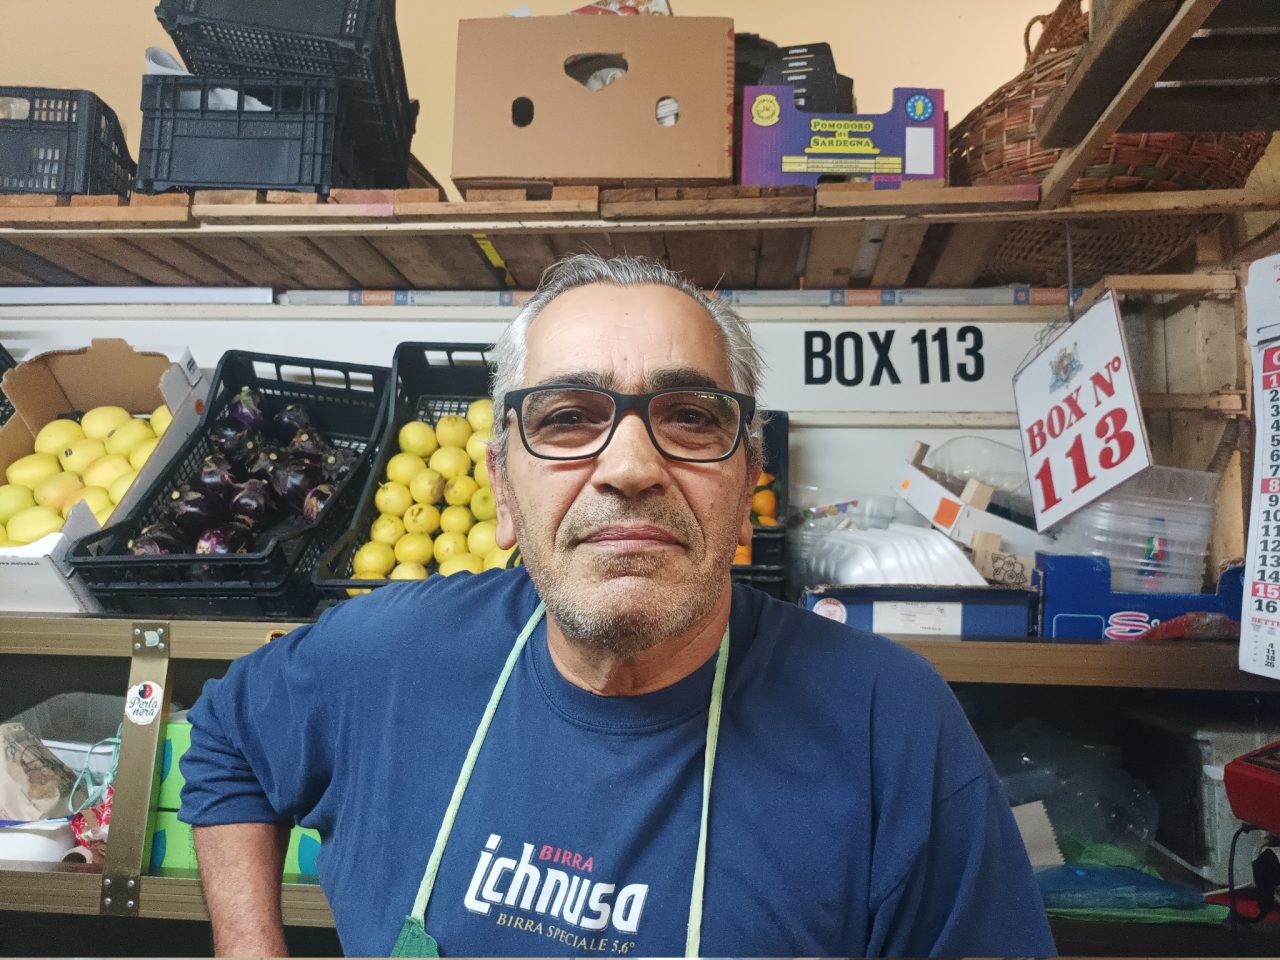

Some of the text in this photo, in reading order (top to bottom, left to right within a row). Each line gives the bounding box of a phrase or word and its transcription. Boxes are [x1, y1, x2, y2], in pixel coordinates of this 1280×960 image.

[812, 121, 871, 130] POMODORO
[812, 138, 872, 147] SARDEGNA
[804, 325, 985, 387] BOX 113
[1026, 386, 1087, 457] BOX
[1034, 407, 1135, 514] 113
[1255, 584, 1279, 597] 15
[1254, 599, 1278, 613] 16
[129, 697, 158, 708] Perla
[132, 708, 155, 716] nera
[539, 845, 594, 873] BIRRA
[497, 913, 543, 935] BIRRA
[547, 925, 608, 951] SPECIALE
